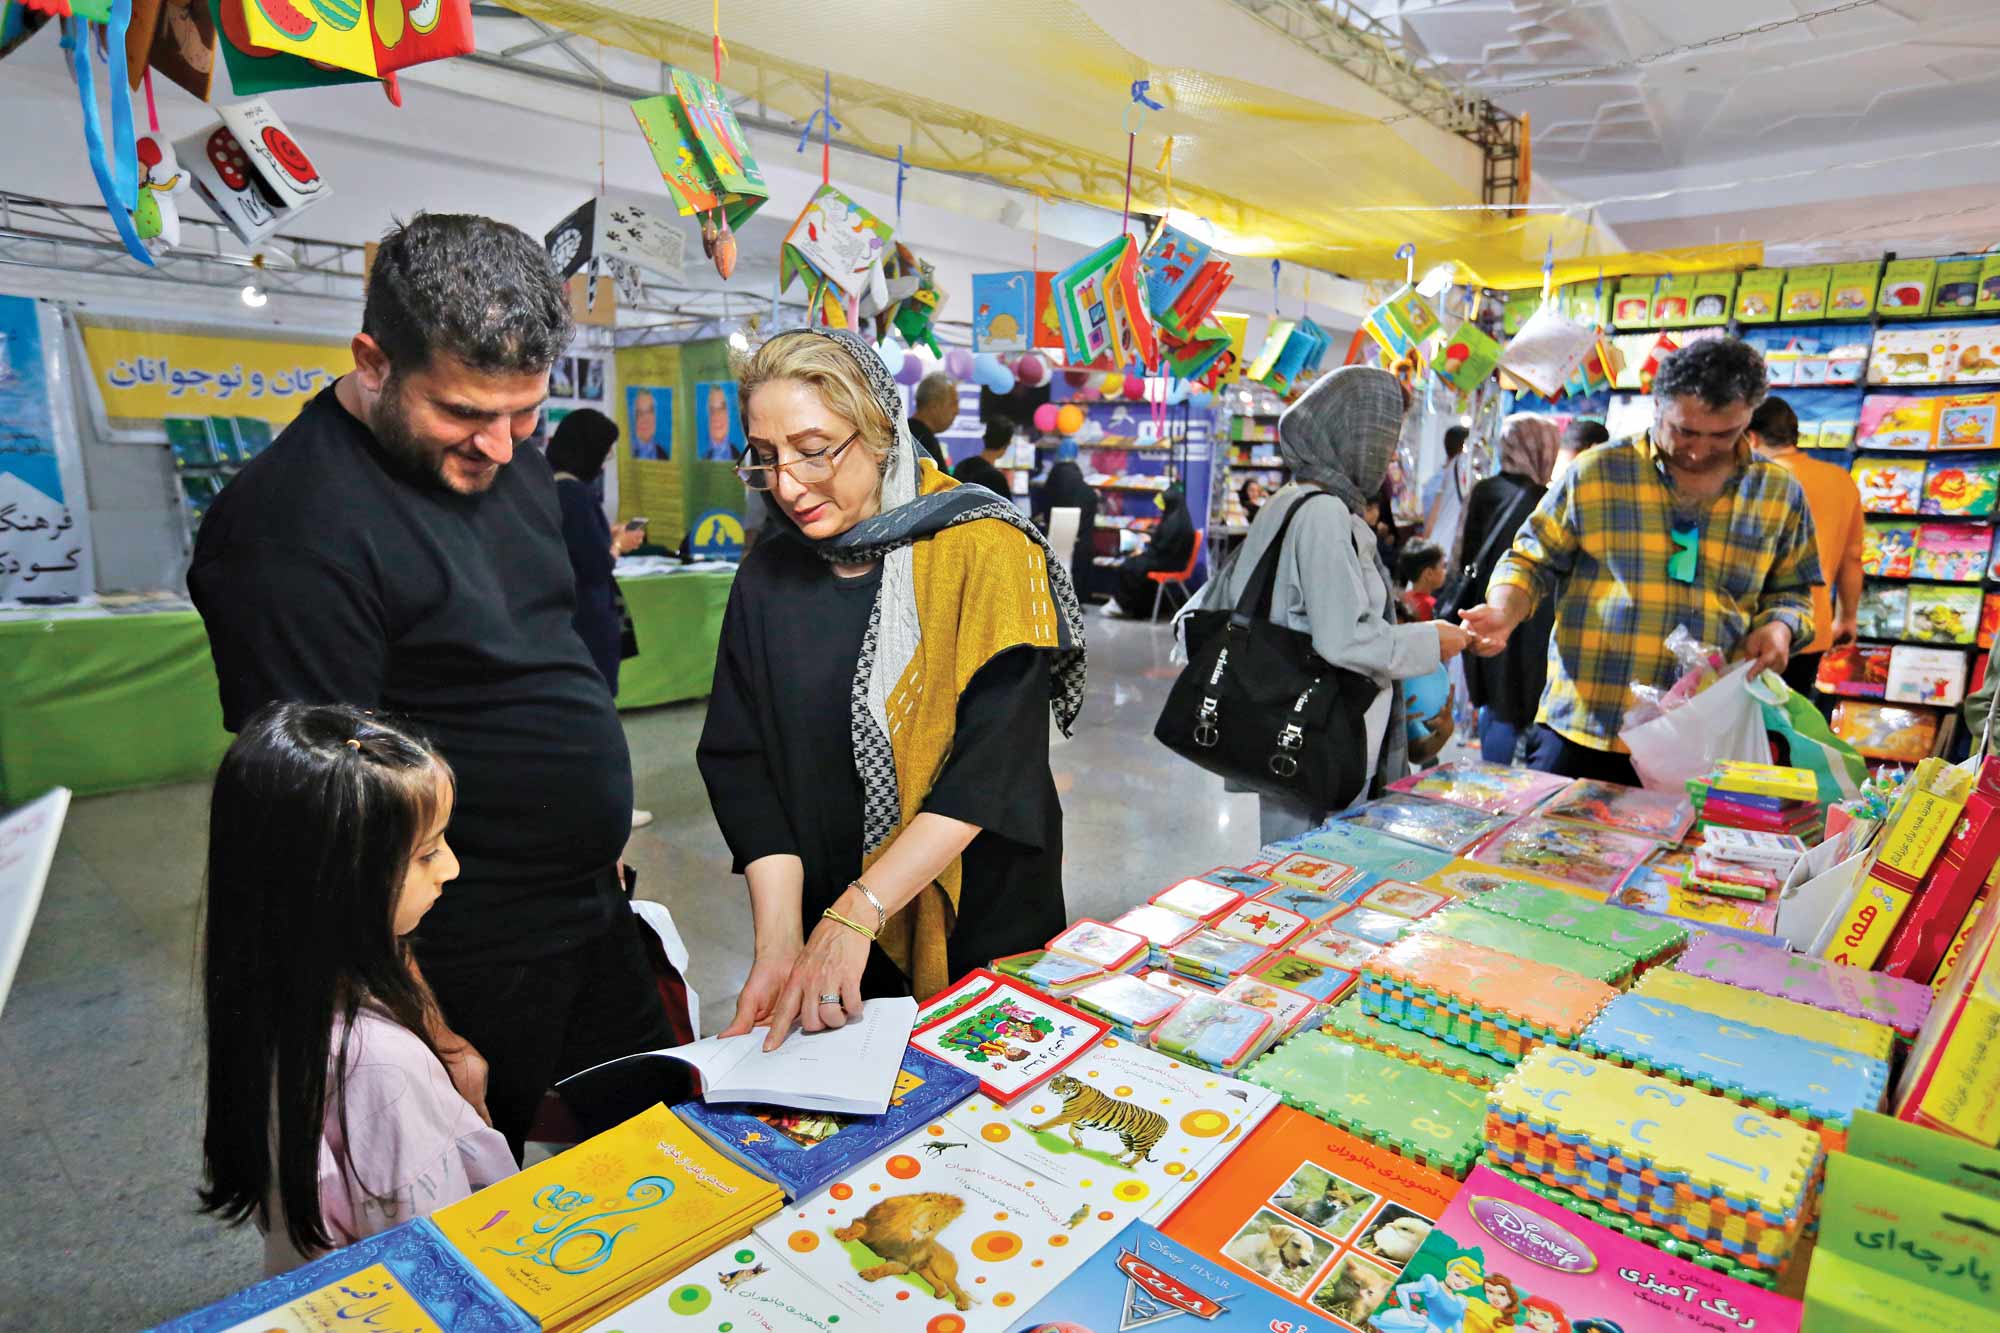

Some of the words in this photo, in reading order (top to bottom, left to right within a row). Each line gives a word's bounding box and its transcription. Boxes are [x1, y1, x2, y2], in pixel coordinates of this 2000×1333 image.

[107, 355, 243, 401] نوجوانان
[250, 372, 265, 397] و
[1326, 1144, 1376, 1171] جانوران
[1378, 1168, 1441, 1197] تصویری
[1148, 1237, 1185, 1265] Disney
[1124, 1260, 1205, 1312] Cars
[1617, 1266, 1700, 1303] آمیزی
[1679, 1273, 1723, 1294] داستان
[1632, 1290, 1673, 1312] ماسک
[1700, 1297, 1758, 1330] رنگ
